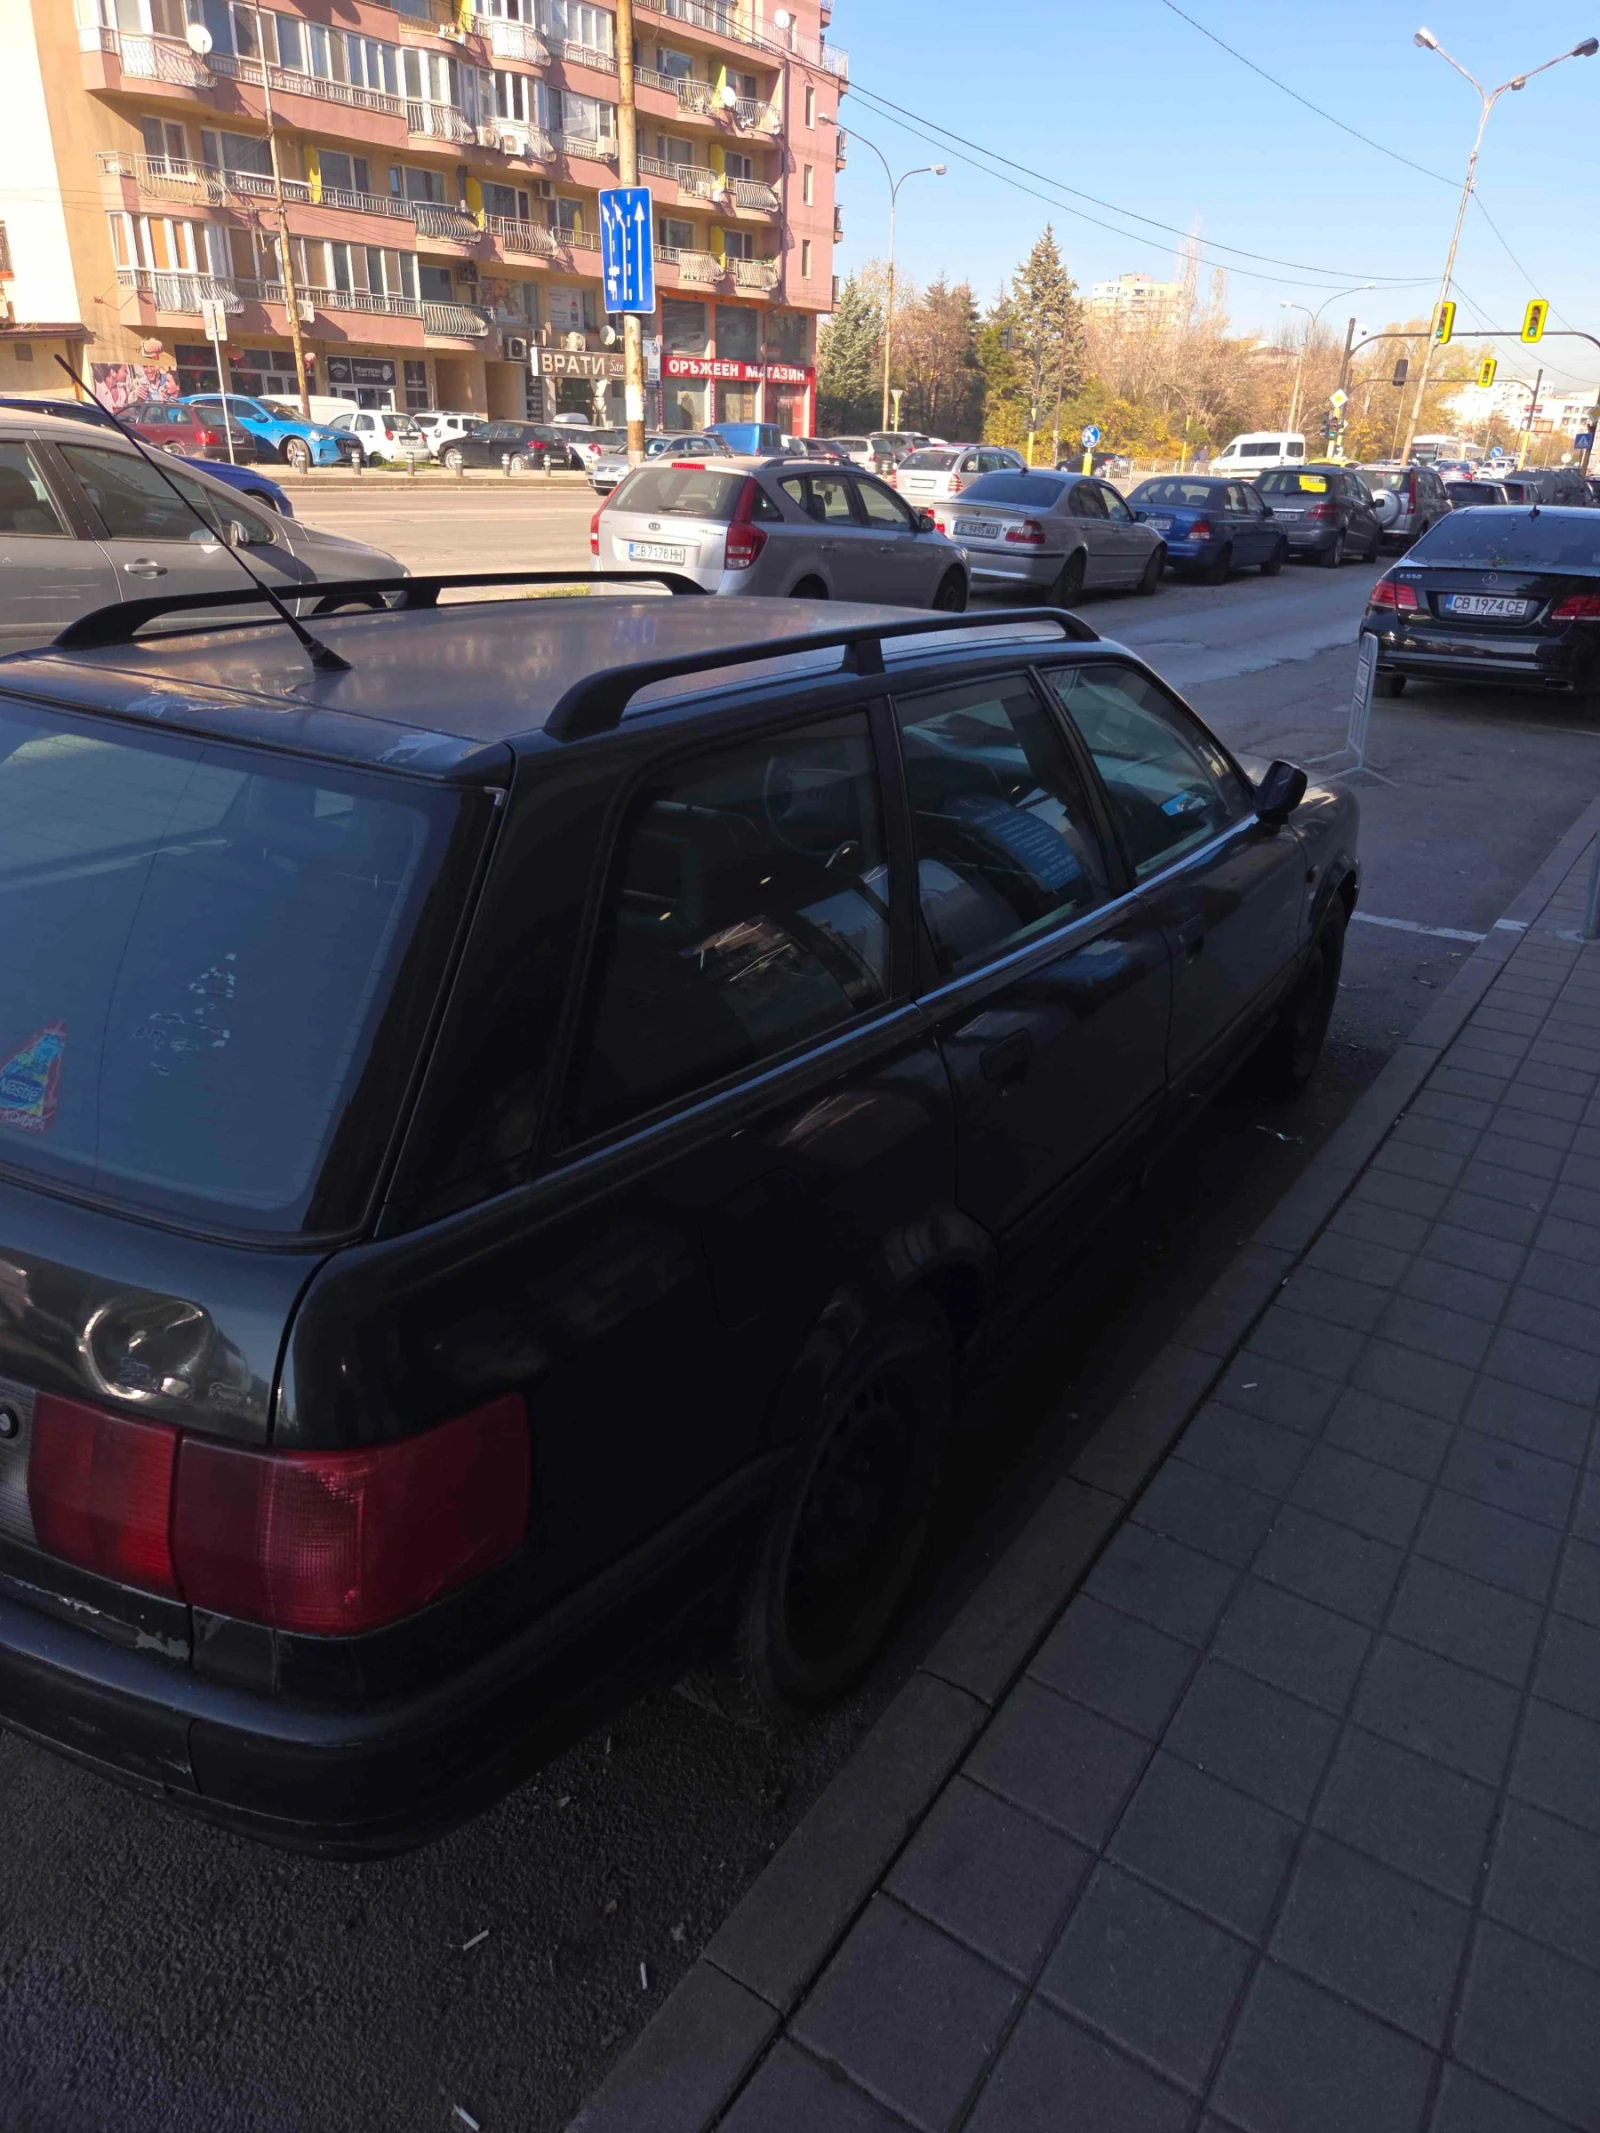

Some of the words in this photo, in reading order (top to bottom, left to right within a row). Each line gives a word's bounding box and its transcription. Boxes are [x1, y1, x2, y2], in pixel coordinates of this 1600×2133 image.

[541, 353, 605, 375] ВРАТИ
[669, 360, 739, 377] ОРЪЖЕЕН
[745, 365, 805, 381] МАГАЗИН
[635, 545, 646, 557] CB
[1453, 596, 1471, 610] CB
[1475, 598, 1504, 613] 1974
[1505, 600, 1525, 615] CE
